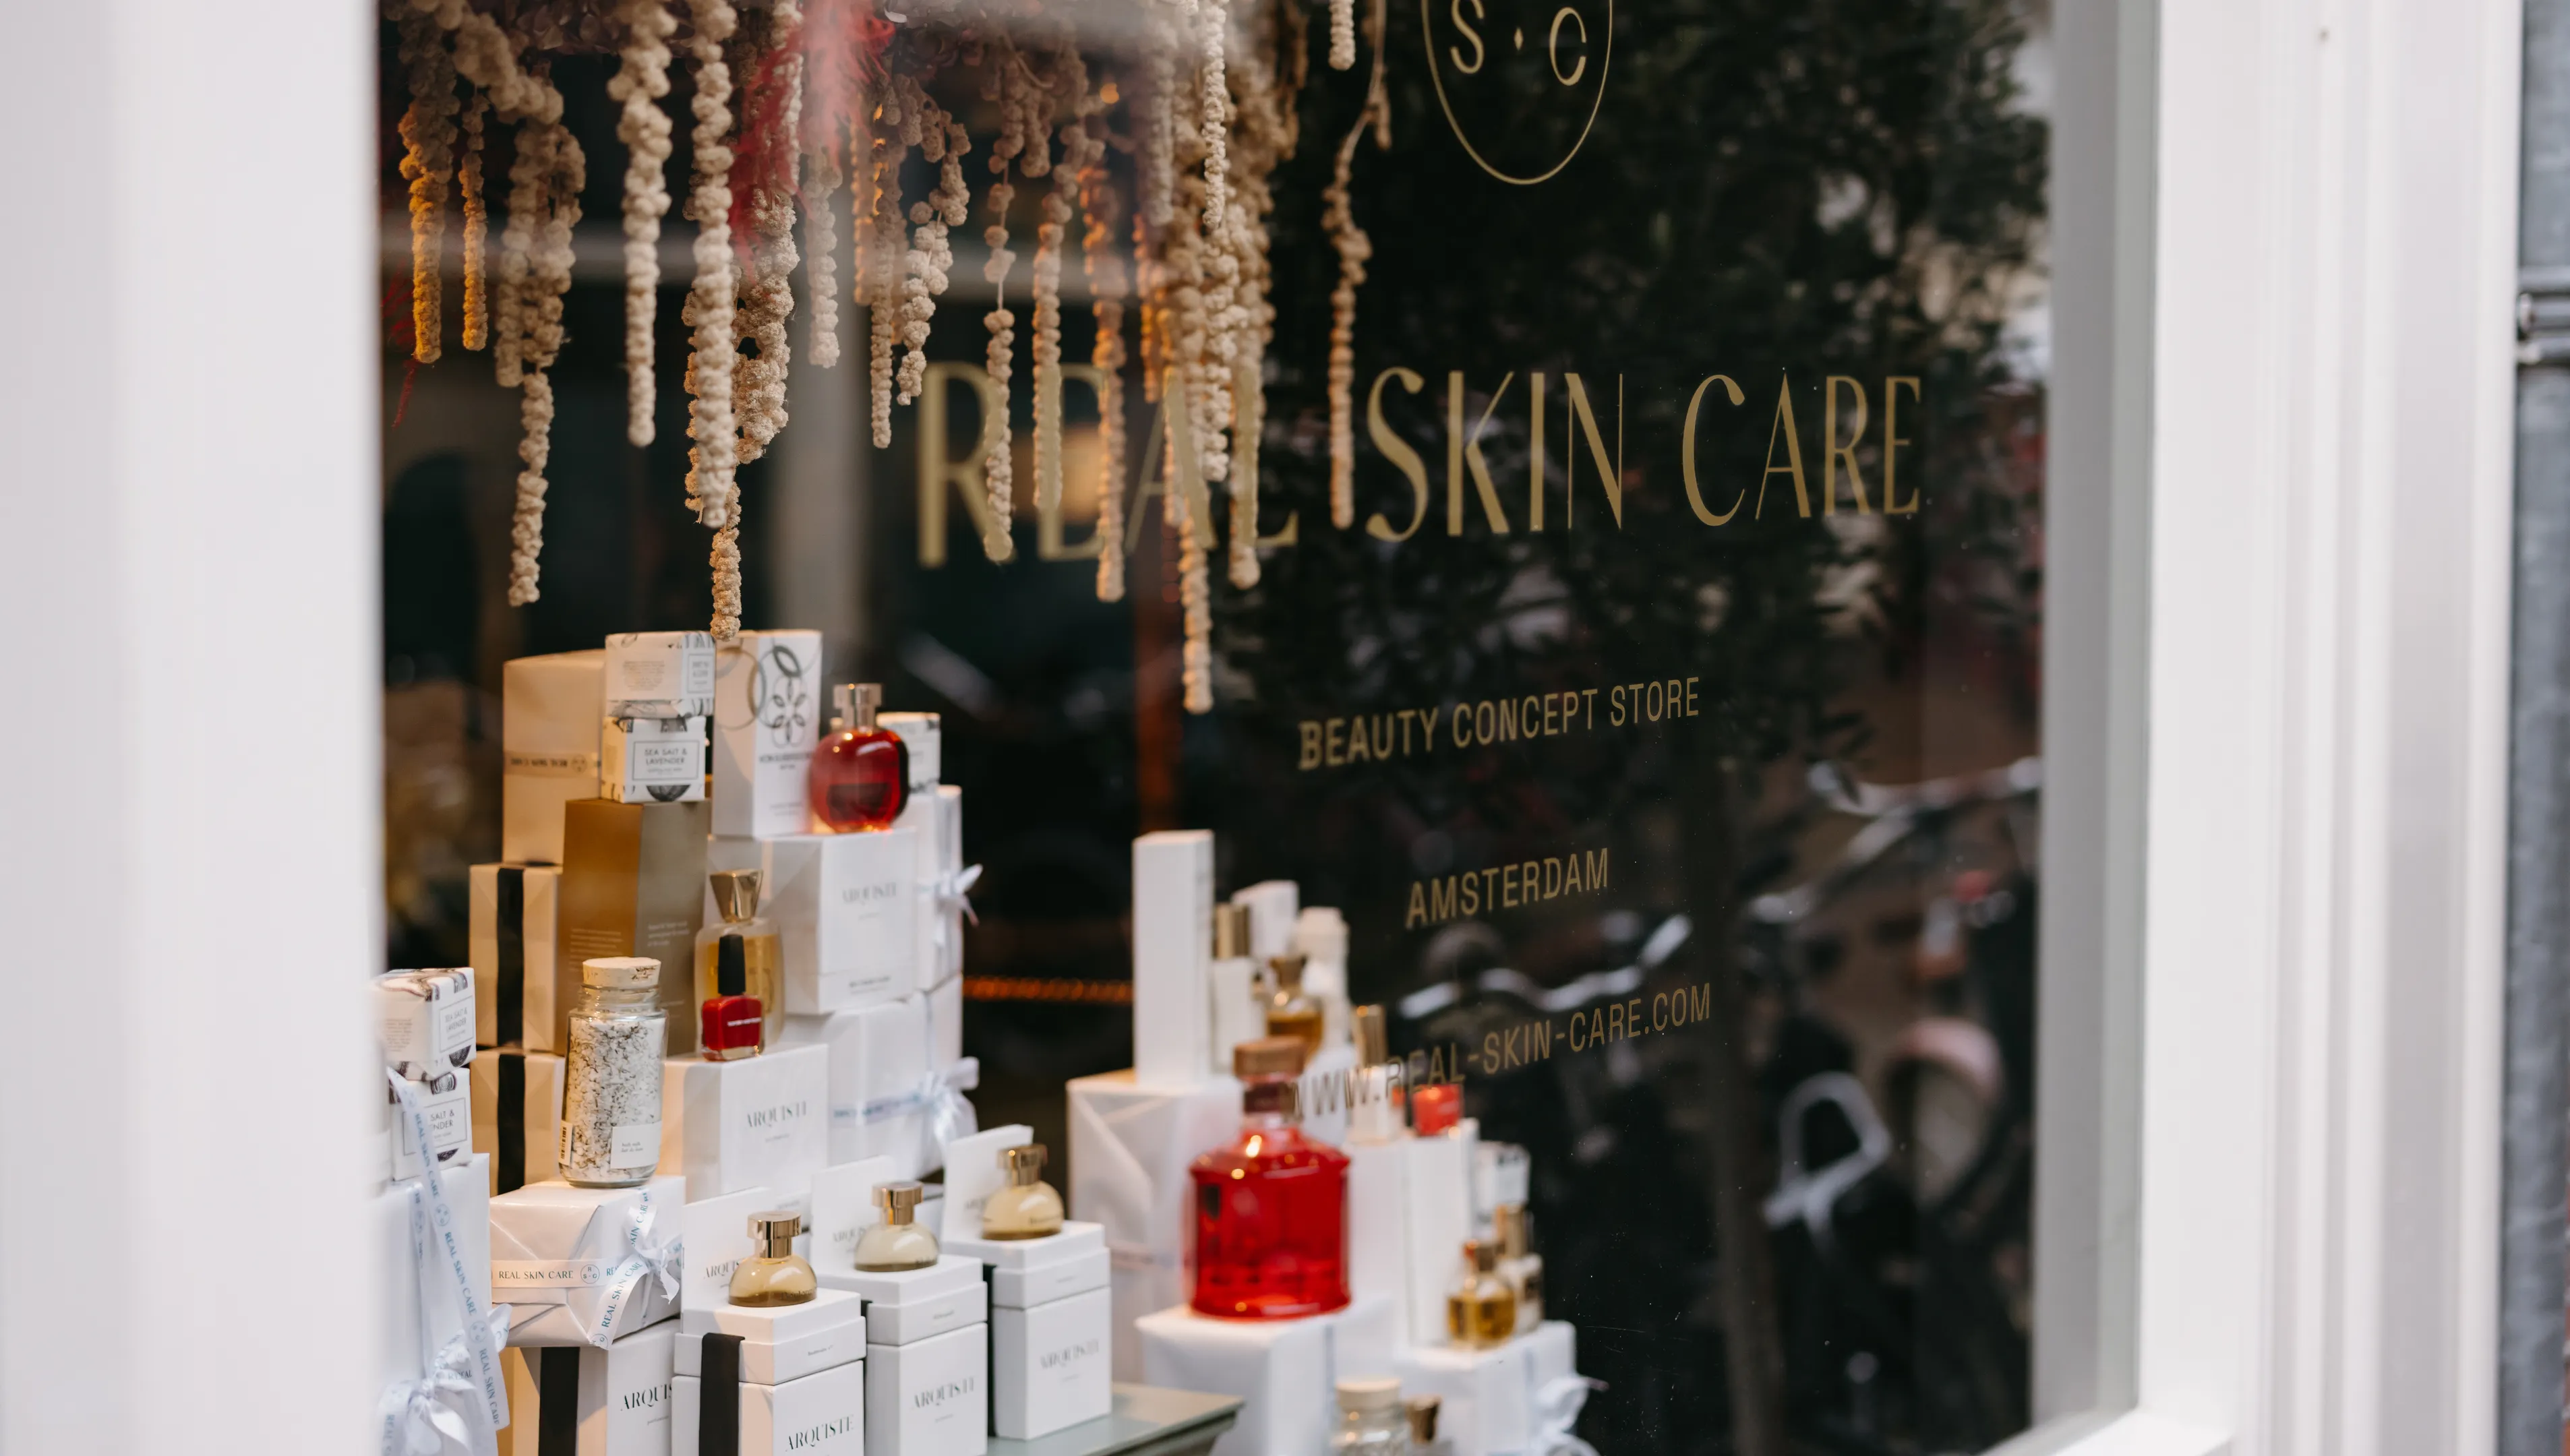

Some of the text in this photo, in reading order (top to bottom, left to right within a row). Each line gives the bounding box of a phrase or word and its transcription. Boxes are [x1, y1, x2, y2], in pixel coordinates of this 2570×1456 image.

[918, 361, 1920, 570] REAL SKIN CARE
[1298, 677, 1700, 771] BEAUTY CONCEPT STORE
[1404, 847, 1609, 929] AMSTERDAM
[430, 1109, 455, 1121] SALT &
[445, 1232, 477, 1316] REAL SKIN CARE
[499, 1270, 574, 1279] REAL SKIN CARE
[601, 1261, 643, 1328] REAL SKIN CARE
[479, 1348, 500, 1424] REAL SKIN CARE
[785, 1414, 854, 1451] ARQUISTE
